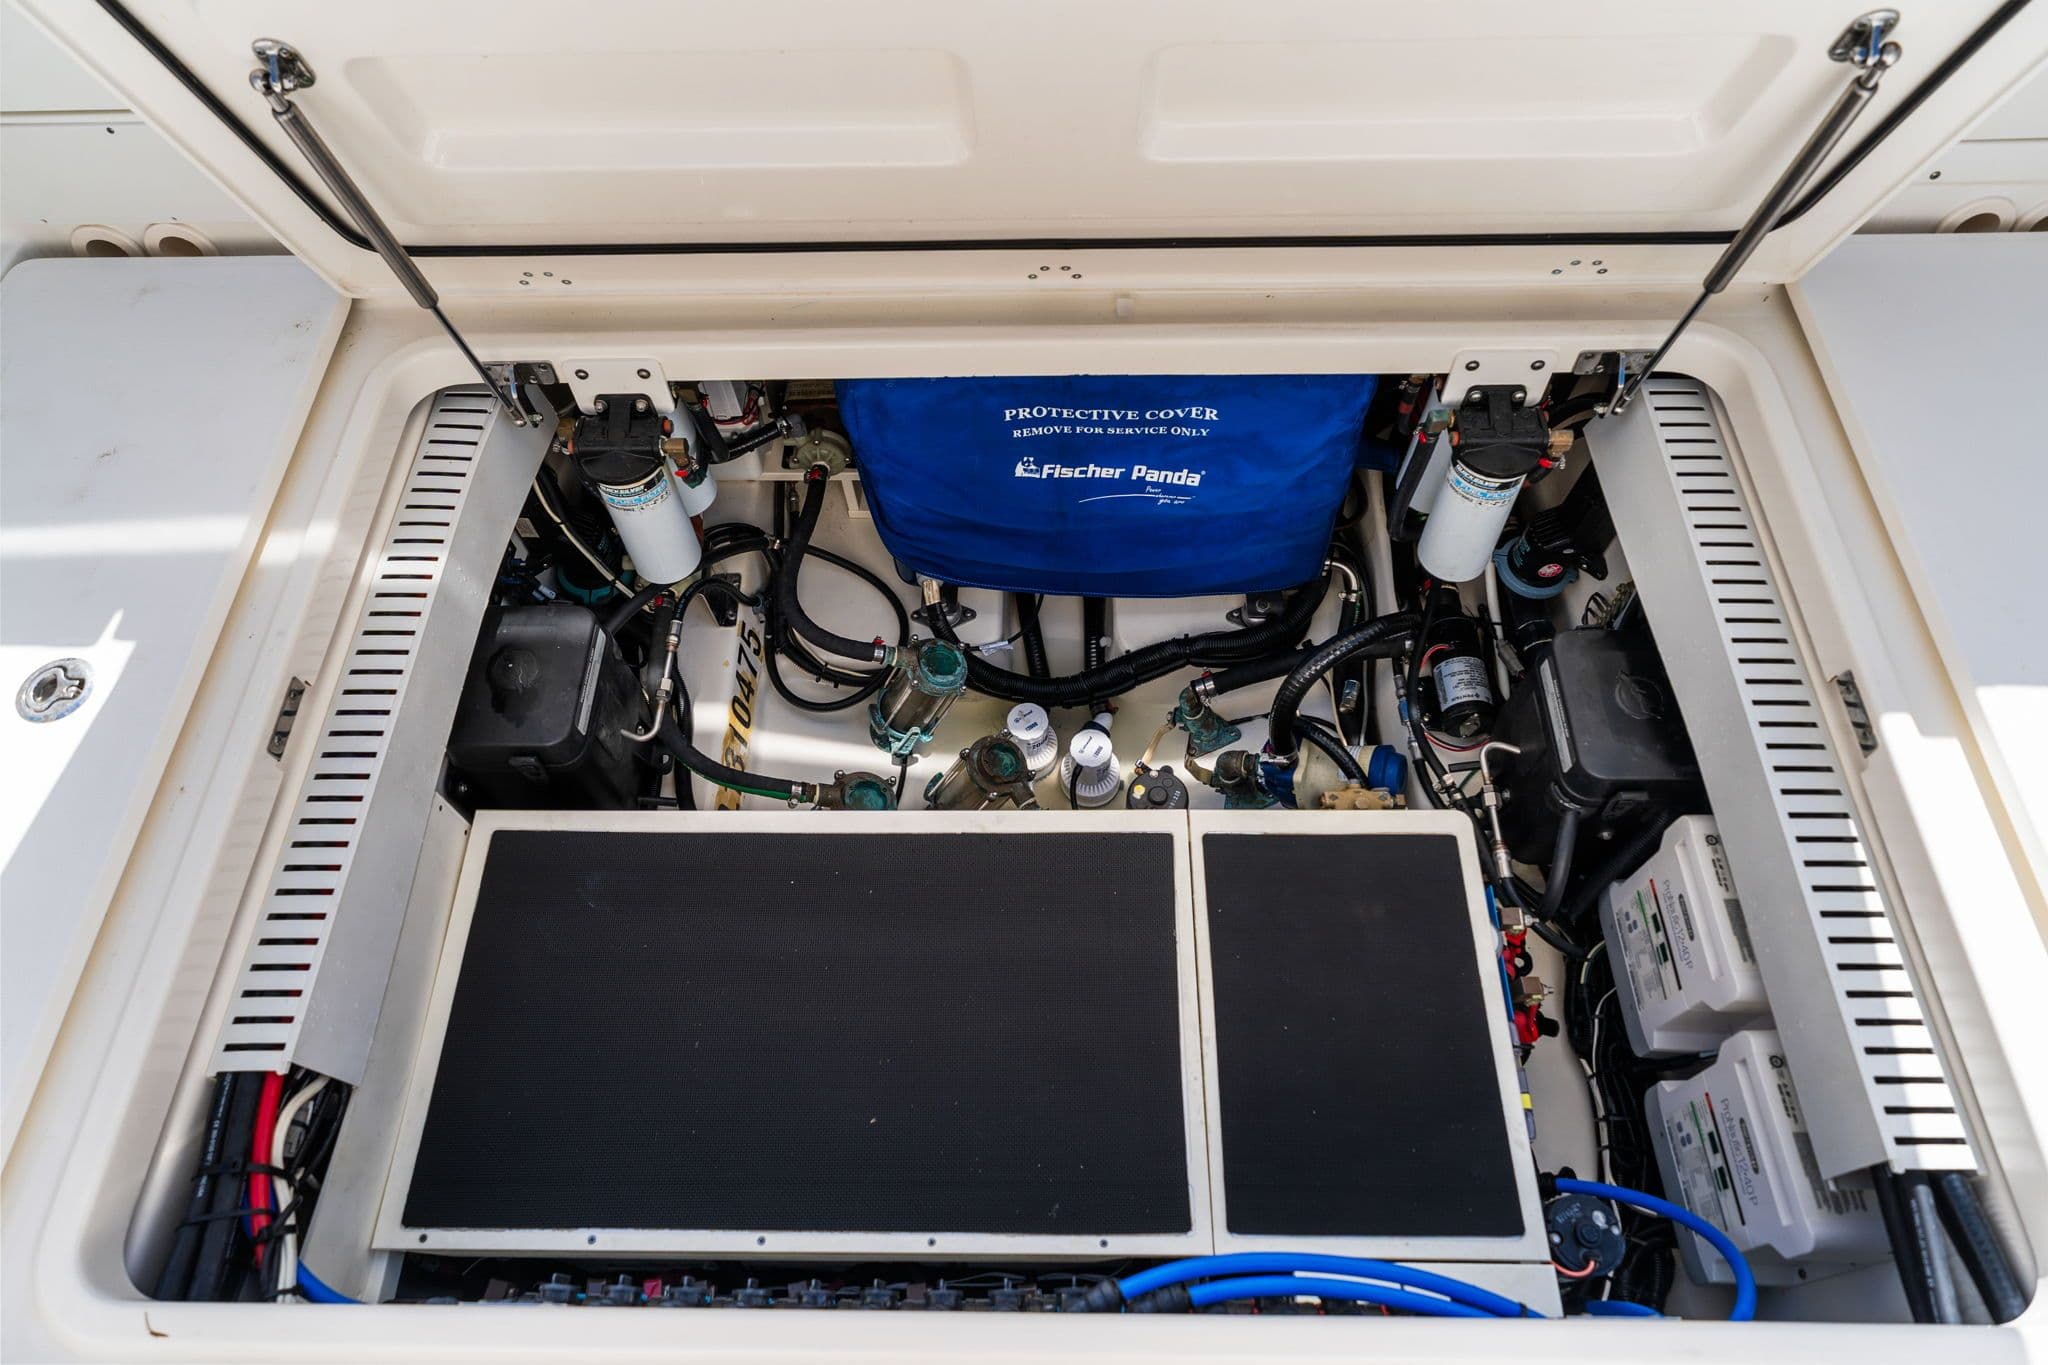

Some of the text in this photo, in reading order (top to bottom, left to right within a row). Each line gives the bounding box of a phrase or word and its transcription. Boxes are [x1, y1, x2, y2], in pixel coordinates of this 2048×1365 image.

[1003, 405, 1219, 421] PROTECTIVE COVER
[1012, 425, 1210, 438] REMOVE FOR SERVICE ONLY
[1041, 463, 1202, 487] Fischer Panda
[717, 621, 763, 811] 310475
